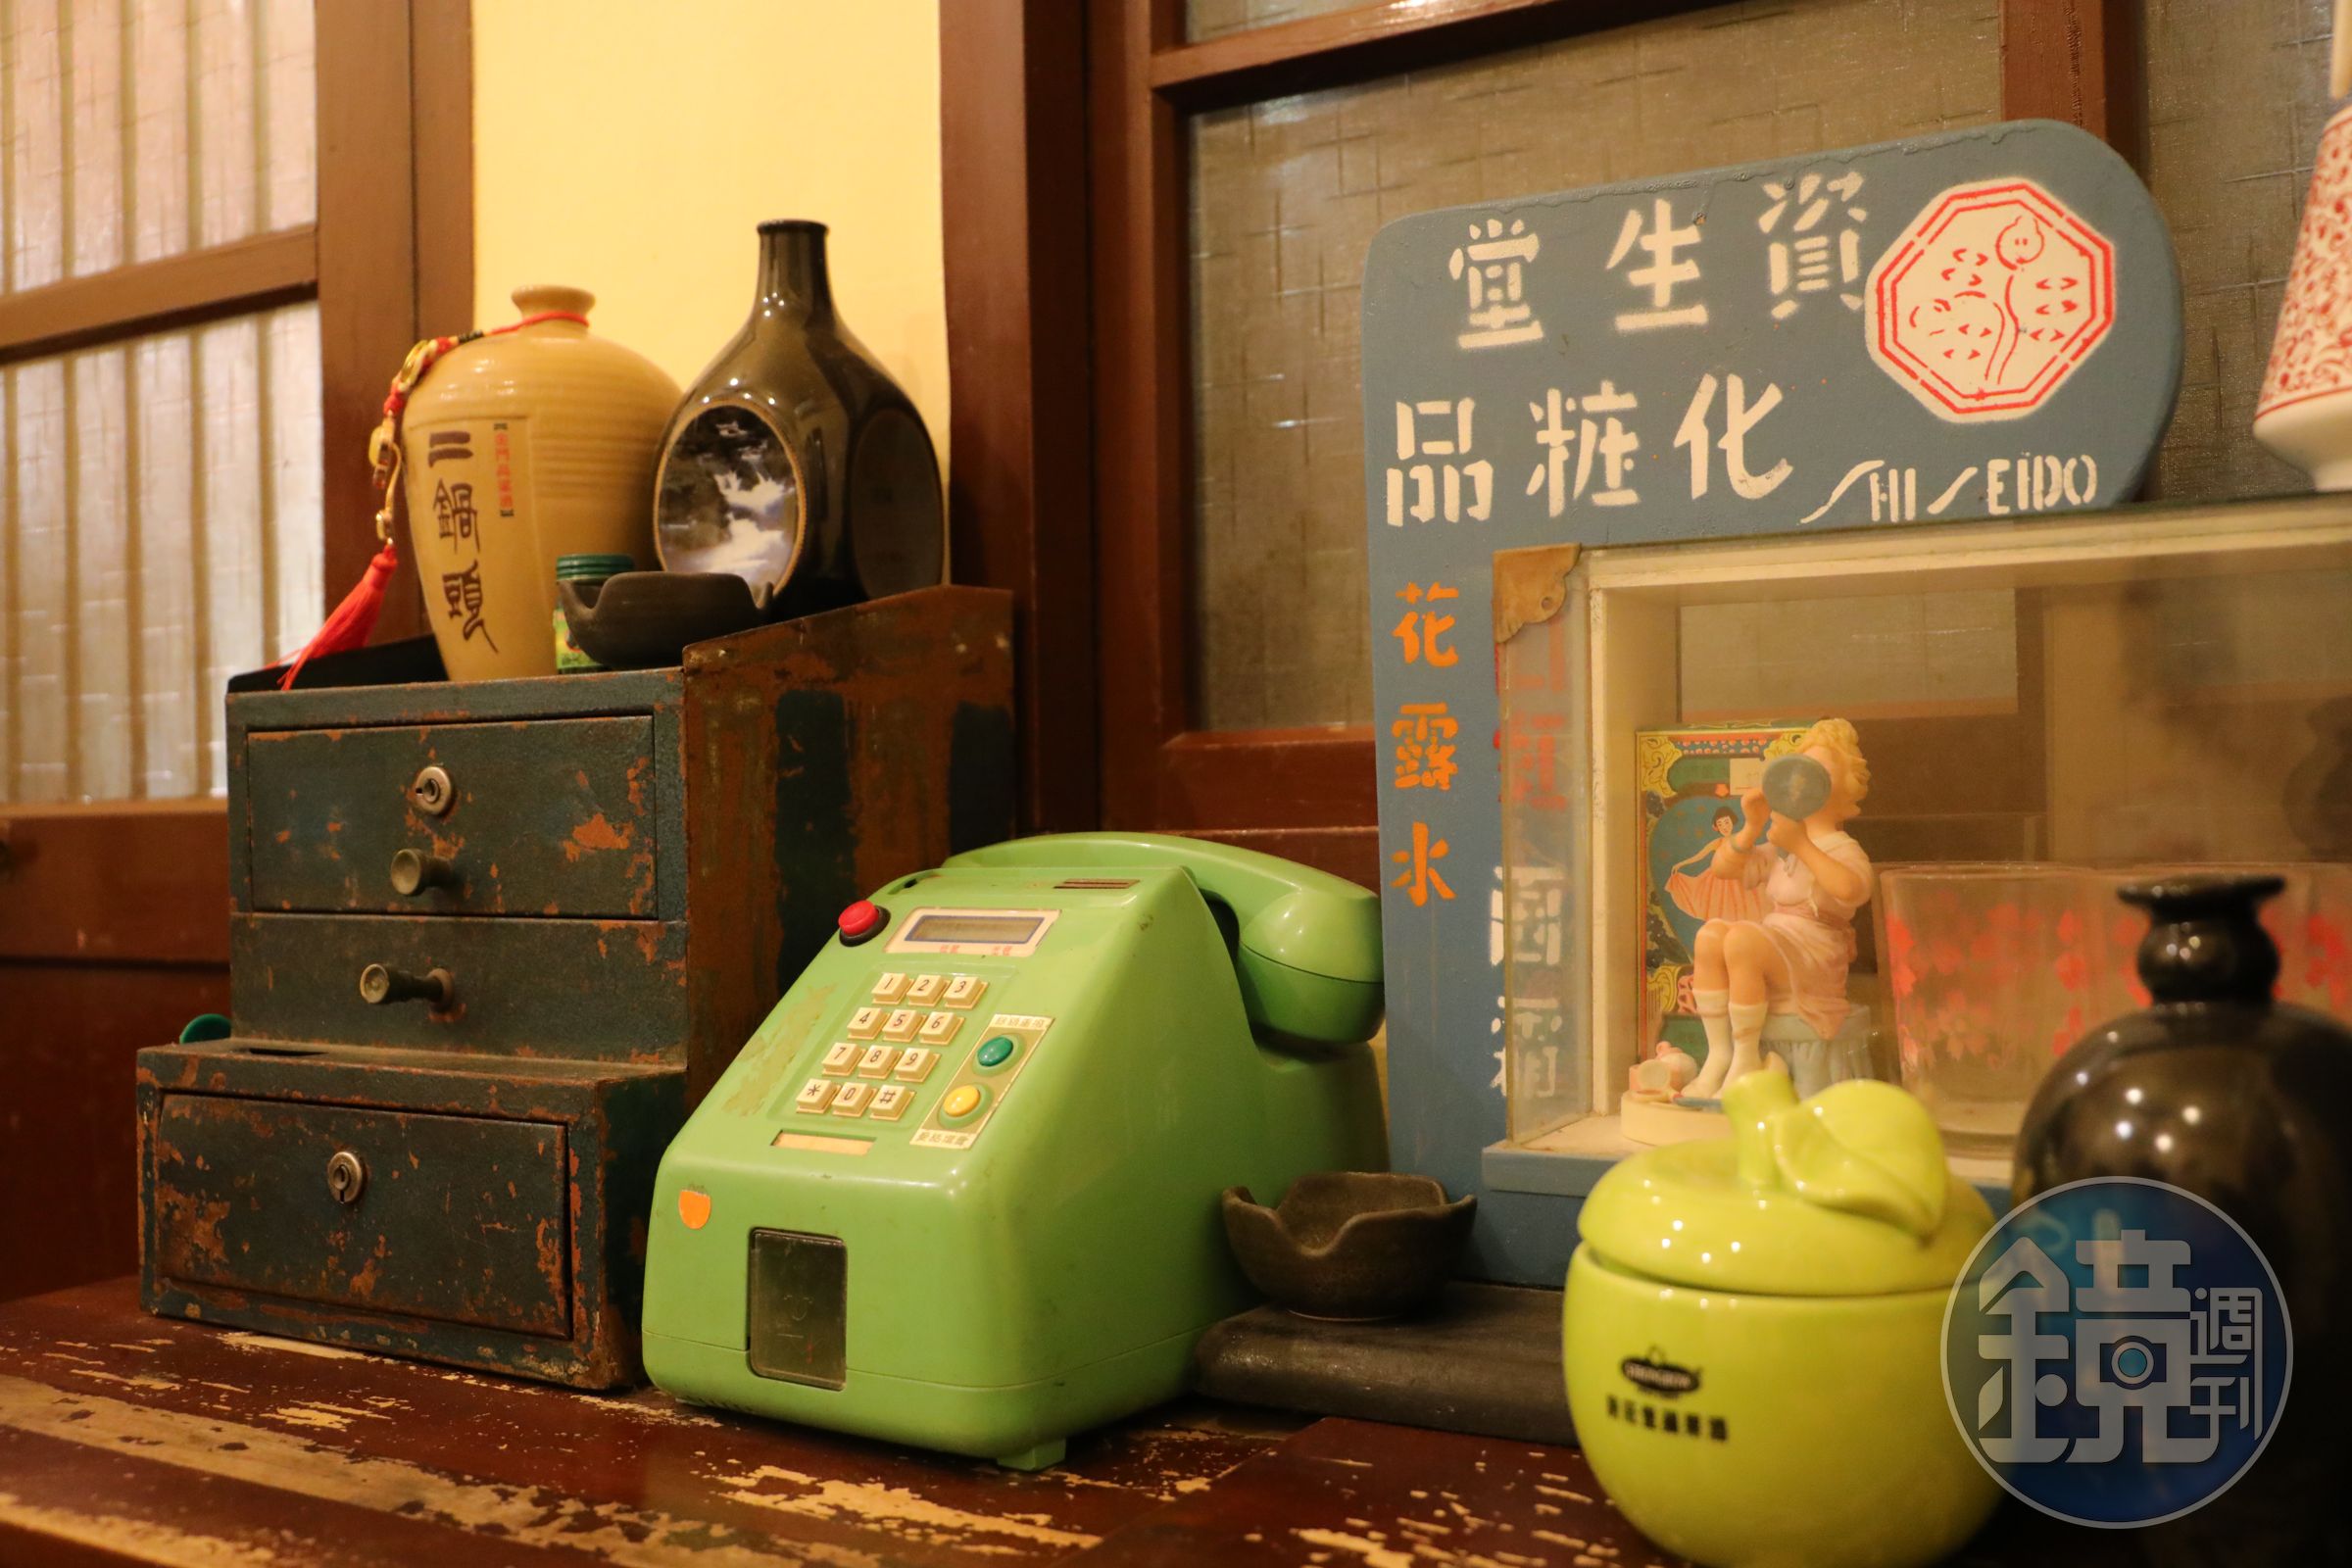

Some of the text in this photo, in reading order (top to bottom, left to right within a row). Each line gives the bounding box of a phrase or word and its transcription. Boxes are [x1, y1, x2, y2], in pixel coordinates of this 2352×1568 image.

[1448, 171, 1869, 350] 資生堂
[1386, 372, 1793, 528] 化粧品
[427, 430, 500, 655] 二鍋頭
[1391, 581, 1460, 906] 花露水
[858, 1010, 944, 1029] 4 5 6
[916, 978, 930, 992] 2
[954, 980, 967, 994] 3
[834, 1047, 918, 1066] 7 8 9
[879, 1090, 897, 1104] #
